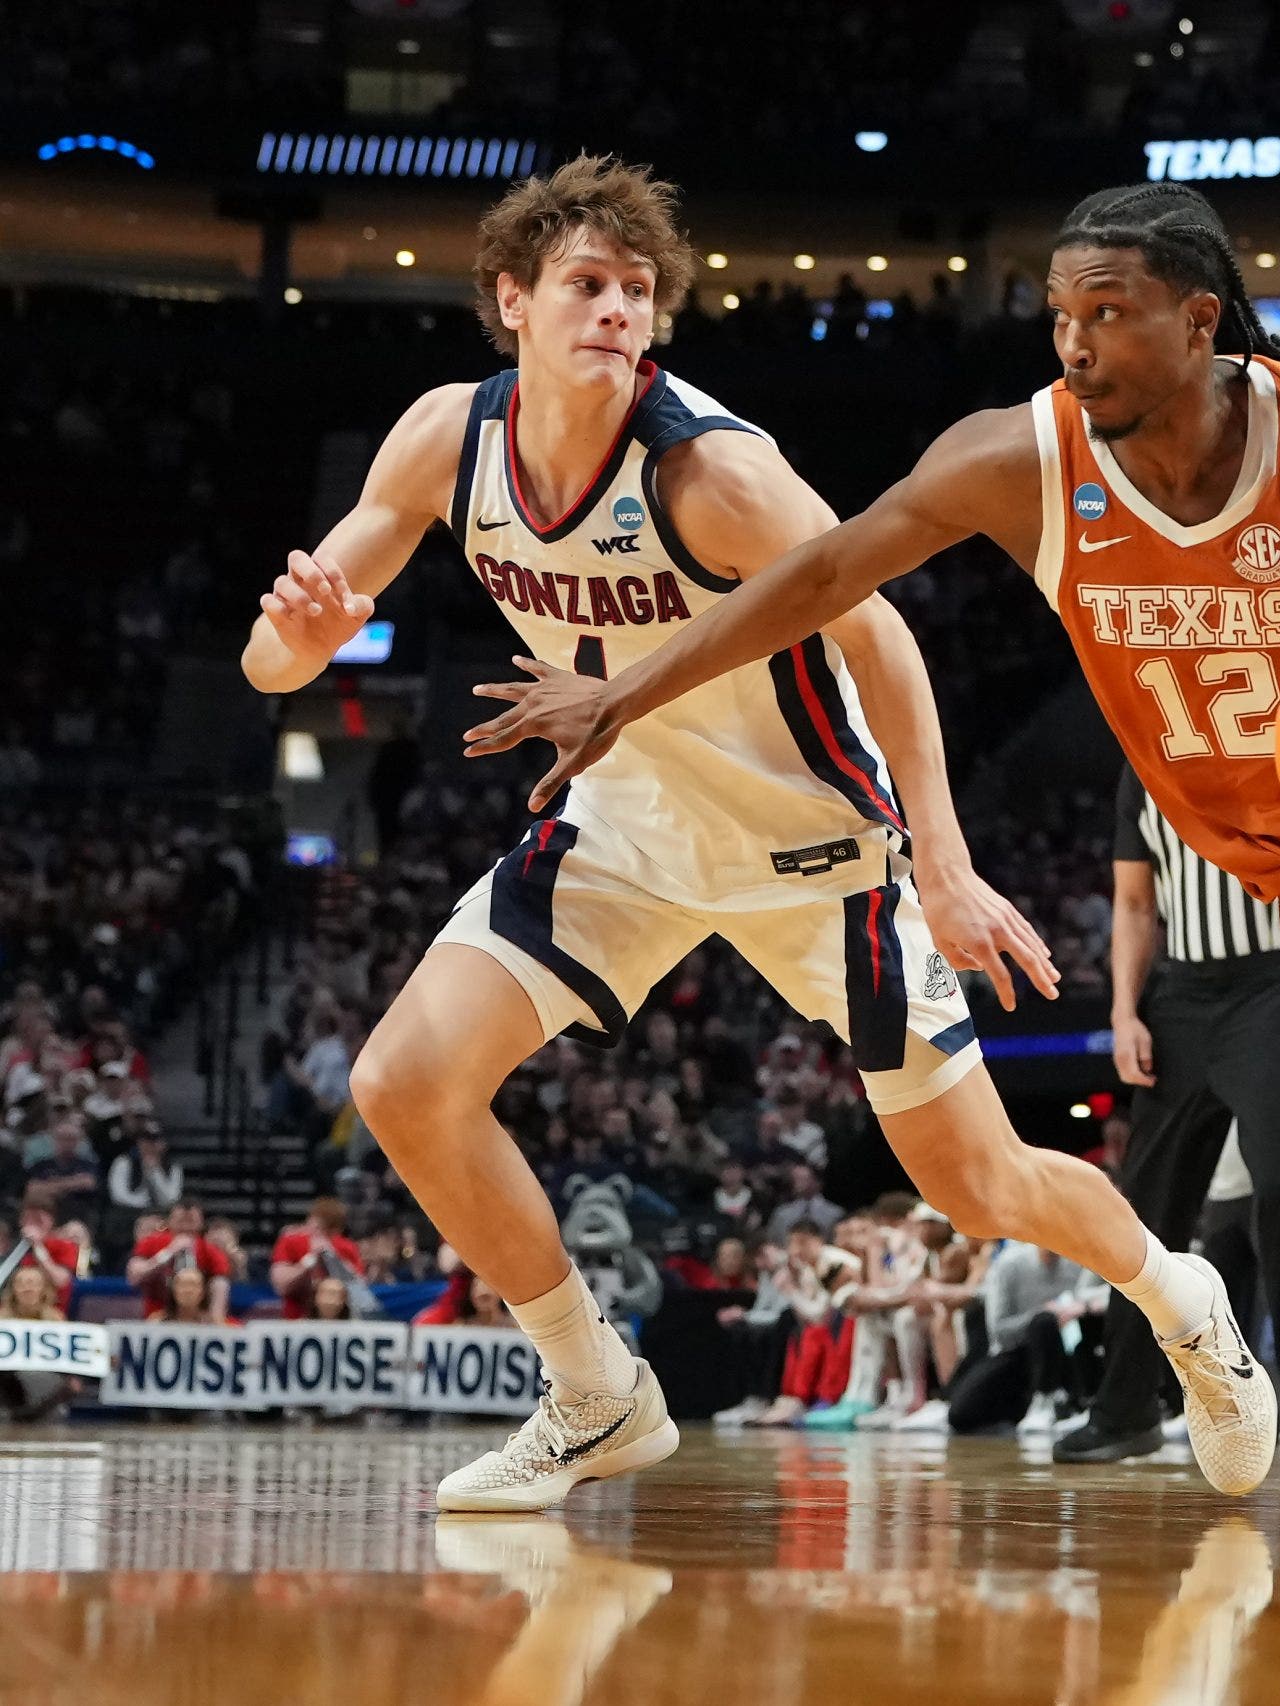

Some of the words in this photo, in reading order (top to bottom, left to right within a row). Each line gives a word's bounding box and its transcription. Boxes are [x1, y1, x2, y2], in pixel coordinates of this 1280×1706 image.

[617, 512, 643, 522] NCAA
[1078, 500, 1105, 511] NCAA
[475, 552, 692, 627] GONZAGA
[1135, 651, 1280, 761] 12
[832, 847, 847, 857] 46
[0, 1331, 92, 1364] OISE
[116, 1336, 247, 1396] NOISE
[260, 1336, 394, 1393] NOISE
